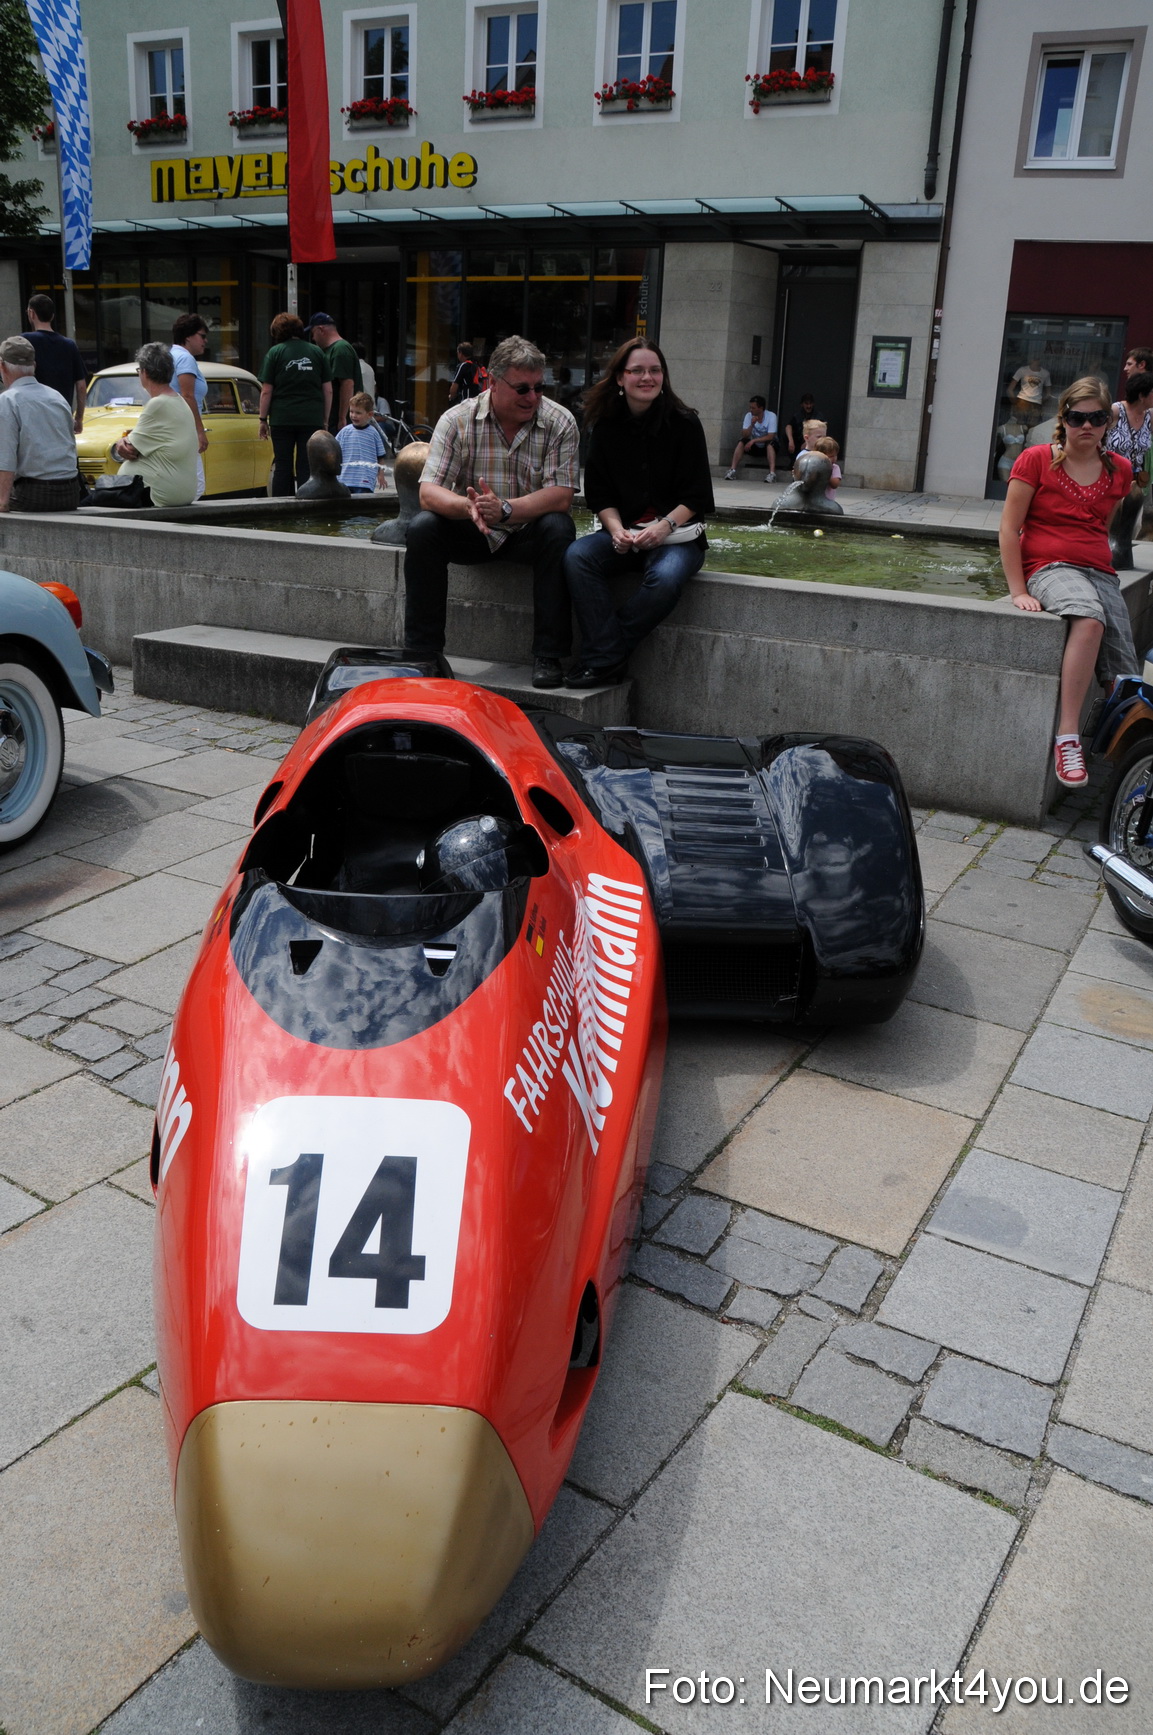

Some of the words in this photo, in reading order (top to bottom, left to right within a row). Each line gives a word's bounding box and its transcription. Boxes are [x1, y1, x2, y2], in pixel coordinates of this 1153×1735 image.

[151, 152, 288, 203] mayer
[330, 141, 478, 195] schuhe
[638, 275, 649, 315] schuhe
[268, 1152, 426, 1309] 14
